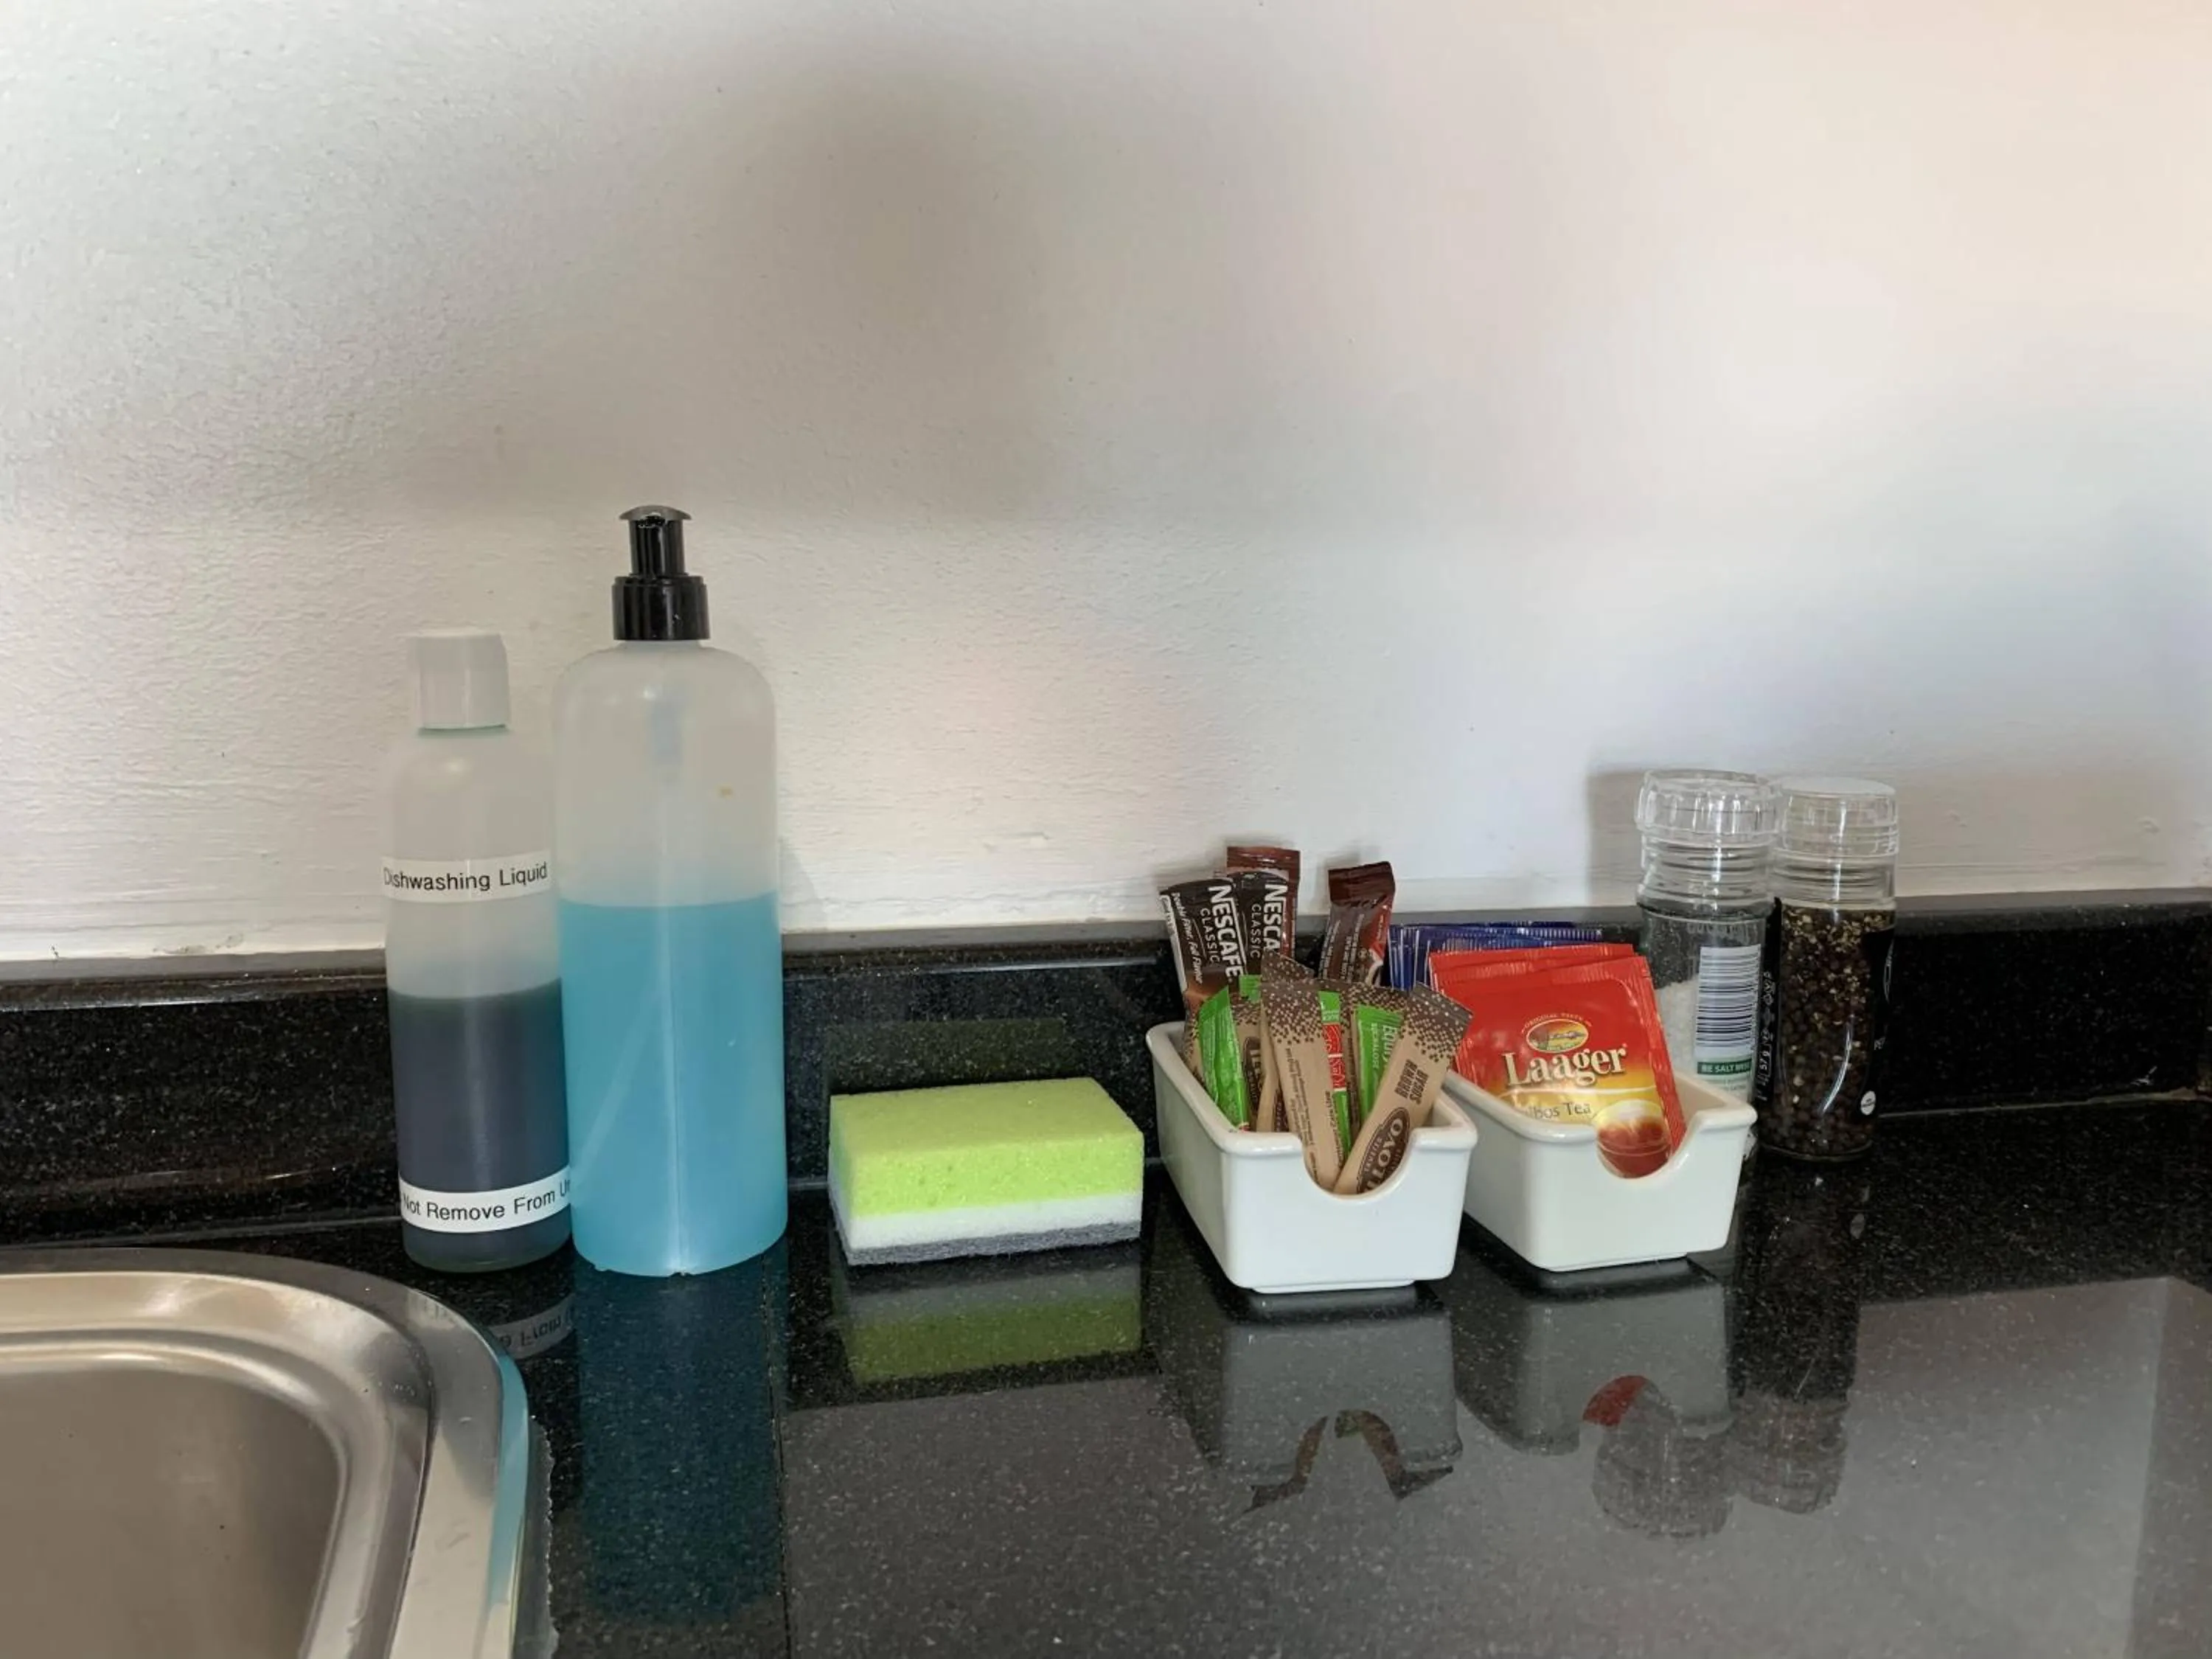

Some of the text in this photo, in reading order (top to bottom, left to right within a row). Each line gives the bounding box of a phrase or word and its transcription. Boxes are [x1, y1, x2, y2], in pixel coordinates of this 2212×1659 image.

[382, 861, 547, 891] Dishwashing Liquid
[1200, 908, 1220, 964] CLASSIC
[1250, 904, 1262, 959] CLASSIC
[1263, 884, 1288, 952] NESCA
[1409, 1069, 1429, 1102] SUGAR
[1501, 1048, 1627, 1087] Laager
[1562, 1102, 1591, 1116] Tea
[427, 1201, 504, 1220] Remove
[514, 1190, 555, 1214] From
